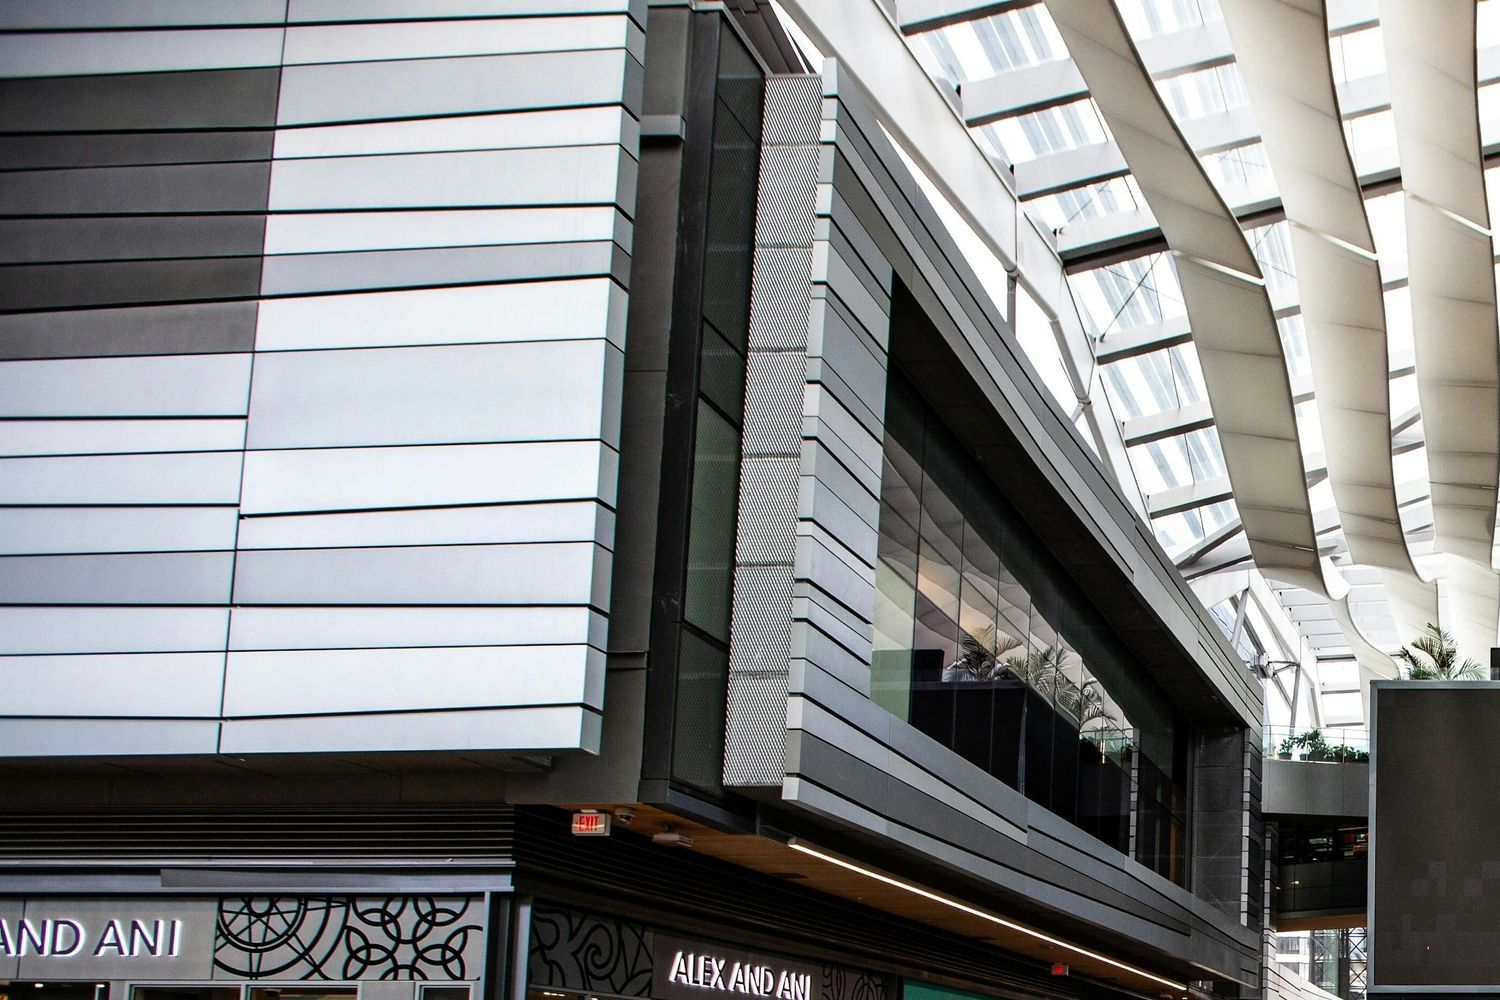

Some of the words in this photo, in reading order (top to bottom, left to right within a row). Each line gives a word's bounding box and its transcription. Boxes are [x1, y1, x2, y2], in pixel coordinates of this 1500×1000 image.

[577, 815, 600, 832] EXIT
[93, 918, 183, 957] ANI
[668, 951, 727, 991] ALEX
[727, 961, 776, 997] AND
